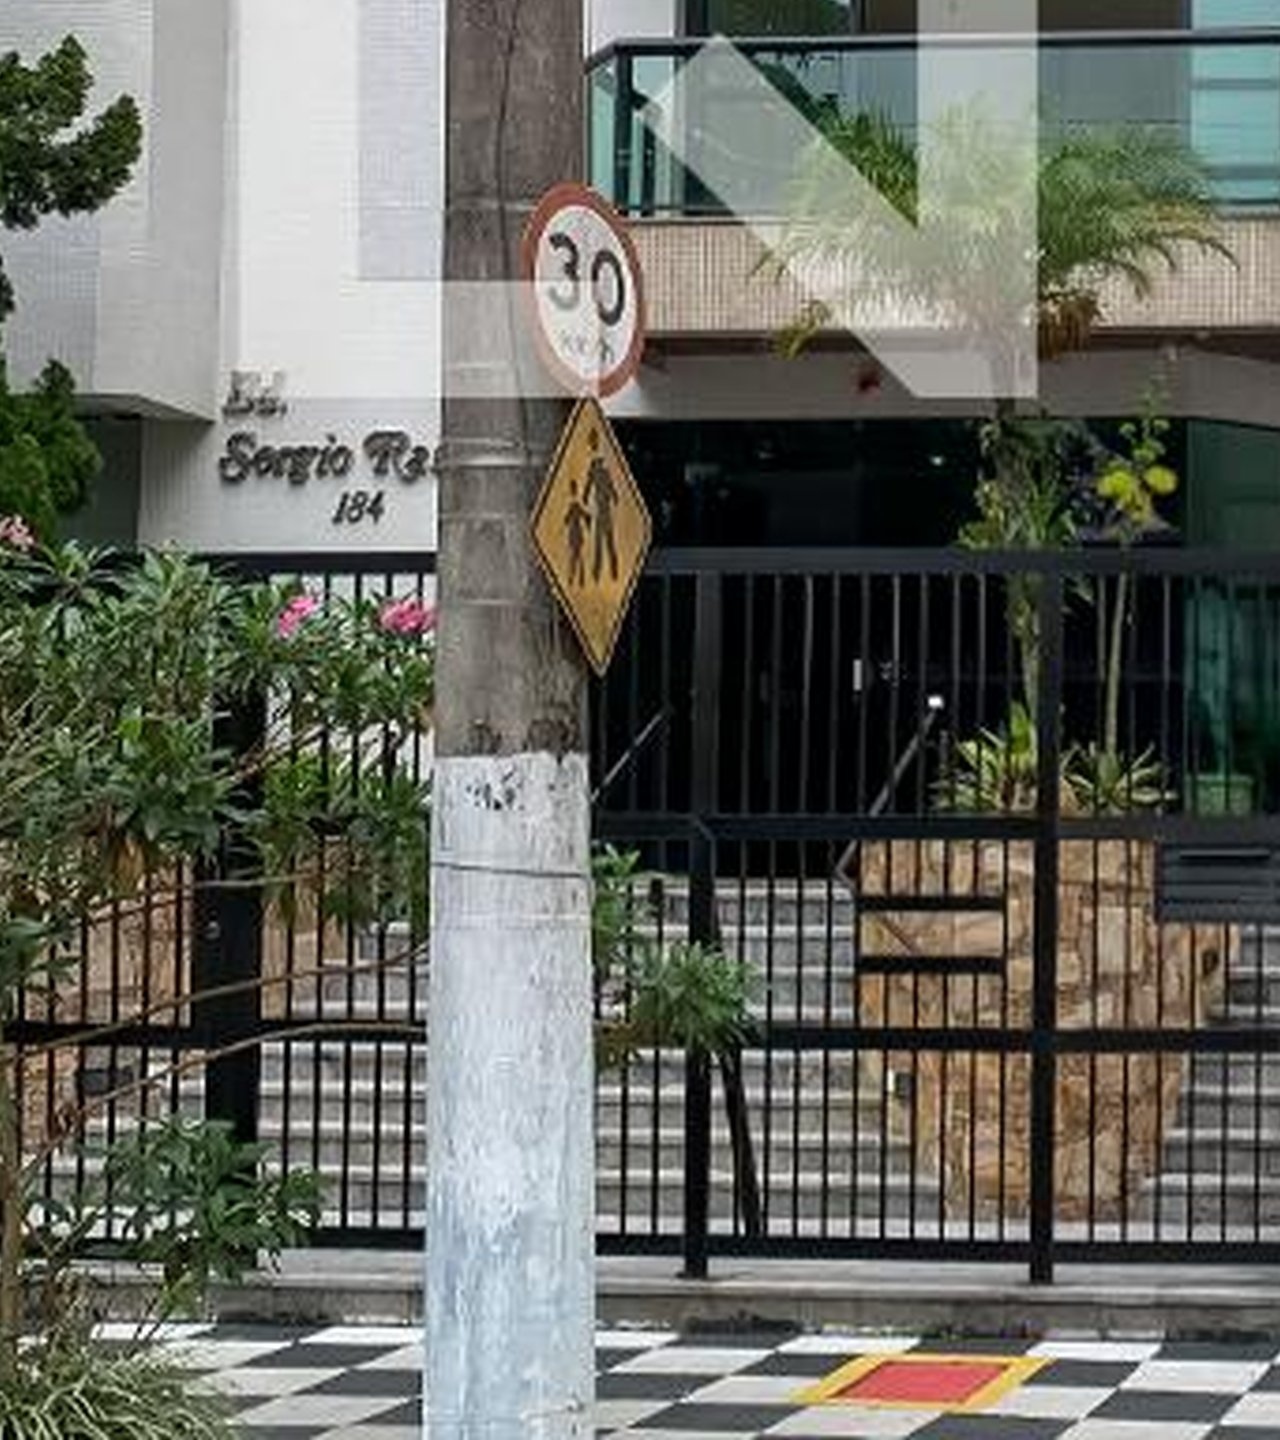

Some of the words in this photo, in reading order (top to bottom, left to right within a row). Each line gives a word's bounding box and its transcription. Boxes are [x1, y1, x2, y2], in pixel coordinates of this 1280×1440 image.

[548, 233, 625, 326] 30
[220, 432, 354, 485] Sergio
[332, 489, 385, 525] 184
